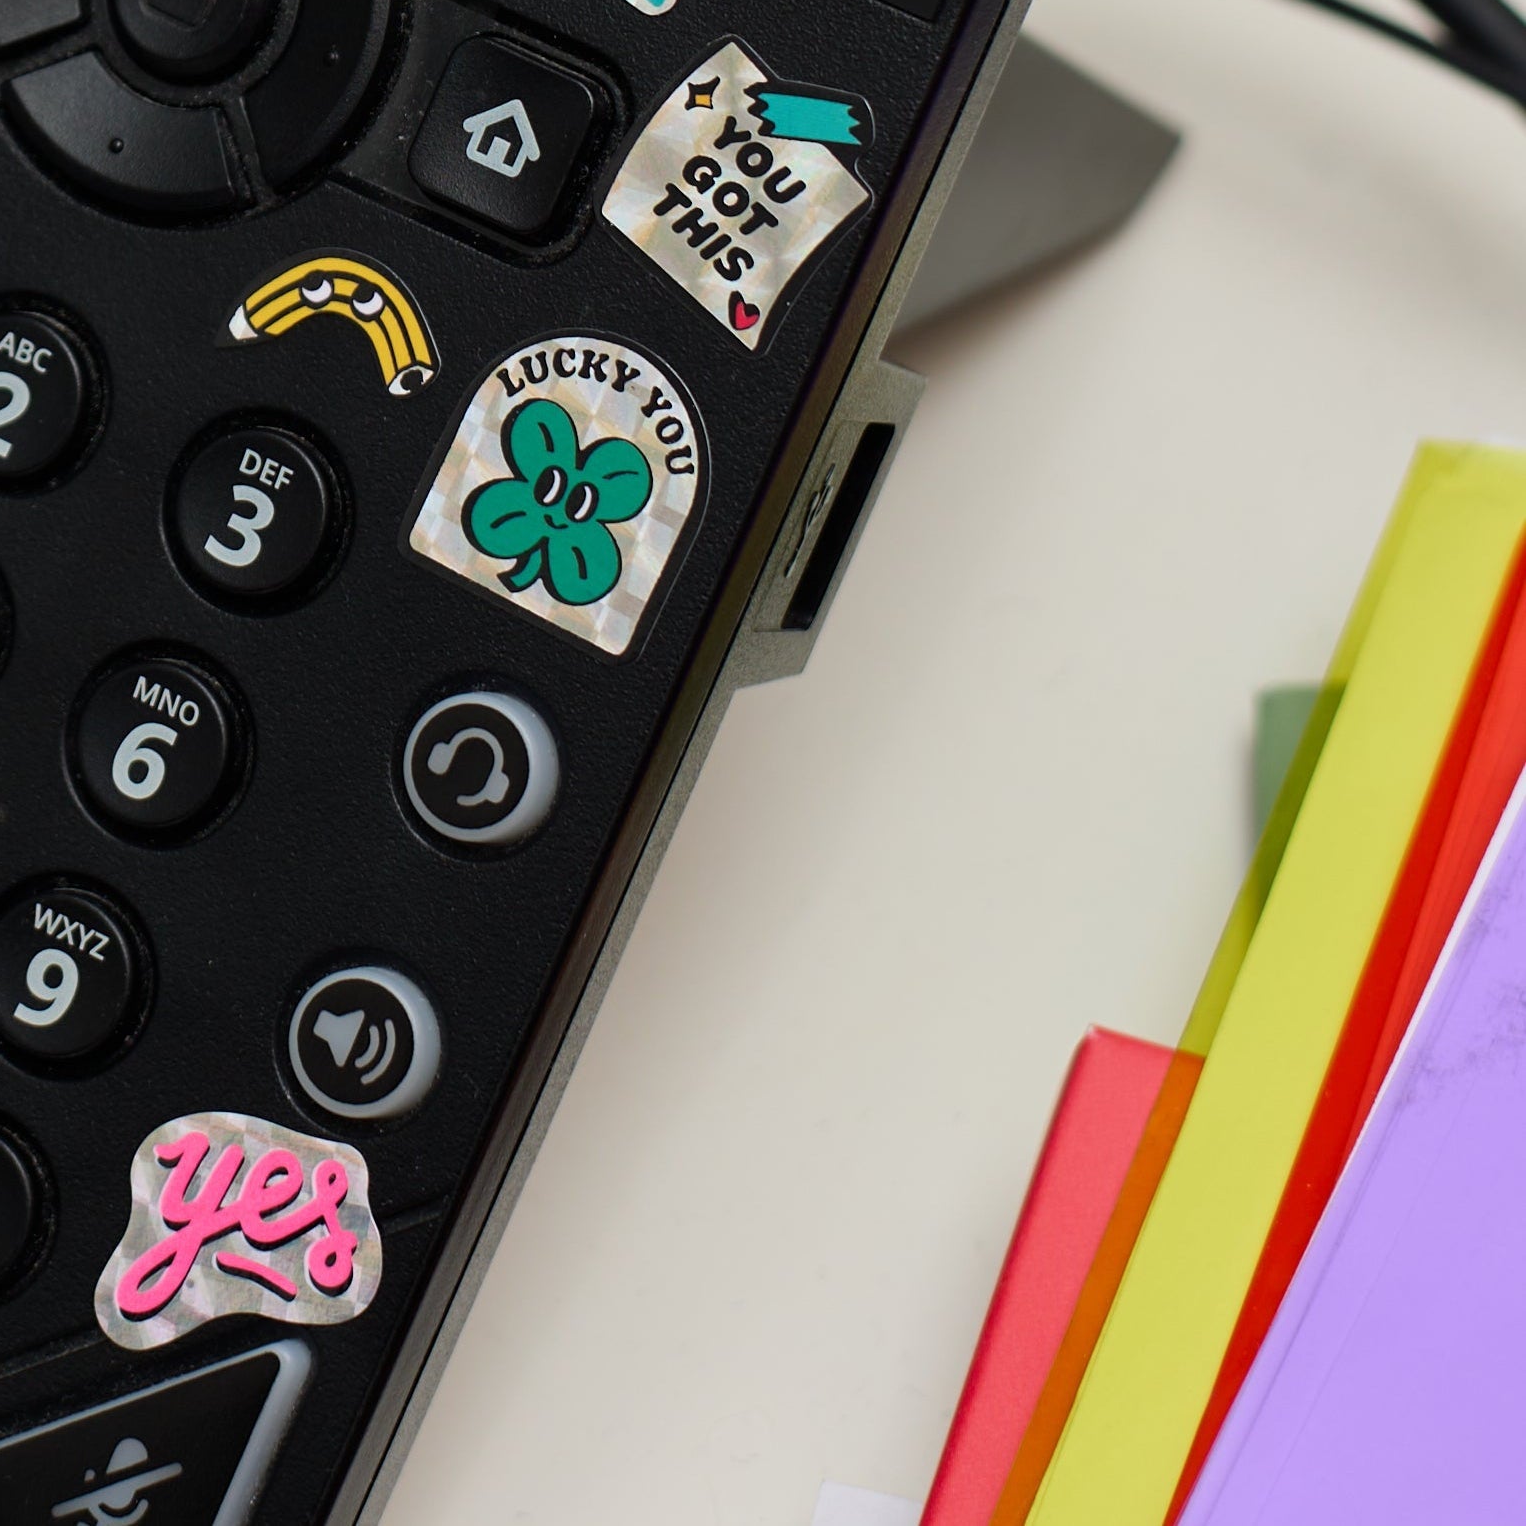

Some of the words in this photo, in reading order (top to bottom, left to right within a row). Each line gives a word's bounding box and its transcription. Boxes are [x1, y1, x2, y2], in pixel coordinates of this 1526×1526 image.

[682, 155, 779, 235] GOT
[713, 115, 807, 204] YOU
[653, 182, 755, 282] THIS
[496, 347, 641, 398] LUCKY
[640, 385, 695, 475] YOU
[238, 448, 295, 491] DEF
[203, 483, 275, 568] 3
[132, 675, 200, 727] MNO
[111, 721, 178, 801] 6
[33, 902, 111, 962] WXYZ
[13, 948, 80, 1027] 9
[114, 1130, 358, 1323] yes
